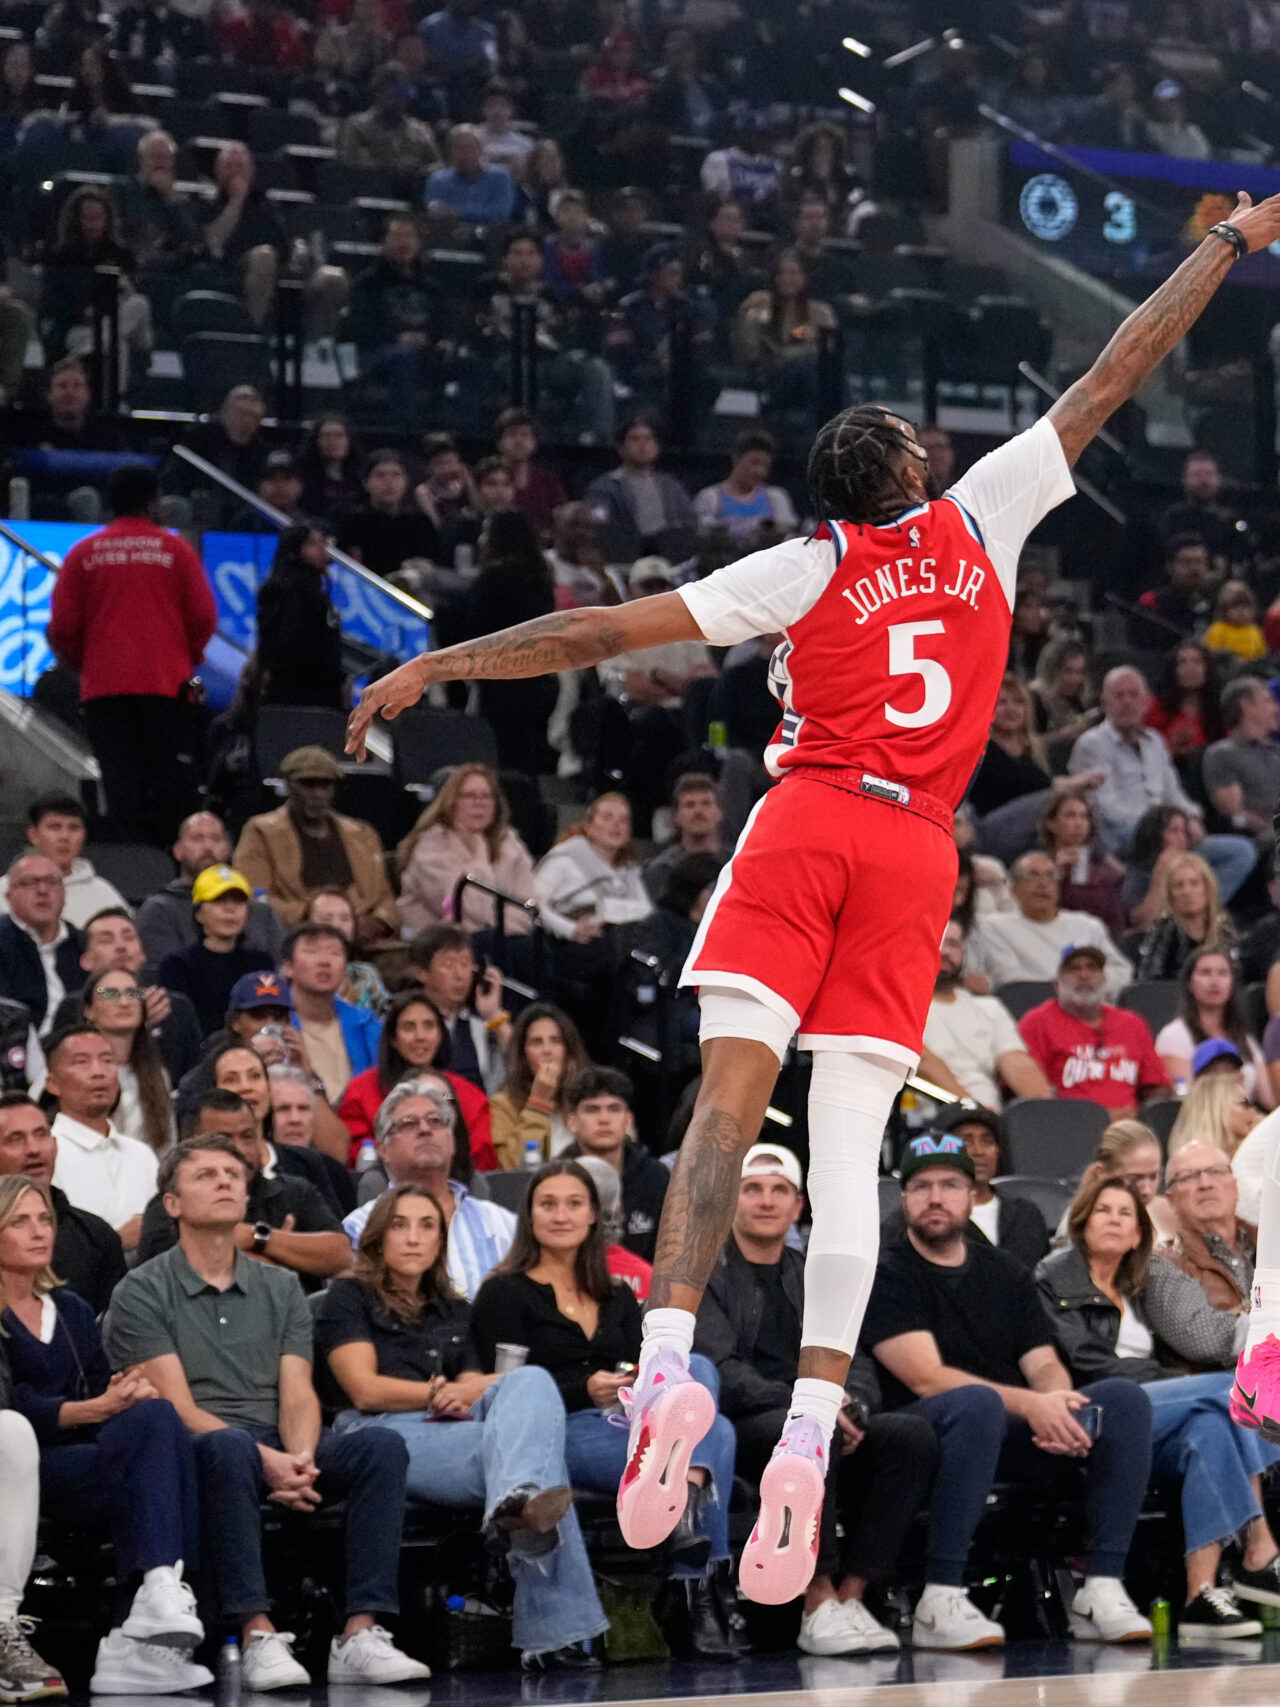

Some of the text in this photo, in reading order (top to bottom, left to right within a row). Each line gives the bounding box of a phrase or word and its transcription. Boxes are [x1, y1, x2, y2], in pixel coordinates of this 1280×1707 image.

[1103, 192, 1136, 243] 3
[130, 551, 175, 568] HERE
[842, 557, 986, 625] JONES JR.
[885, 619, 953, 729] 5
